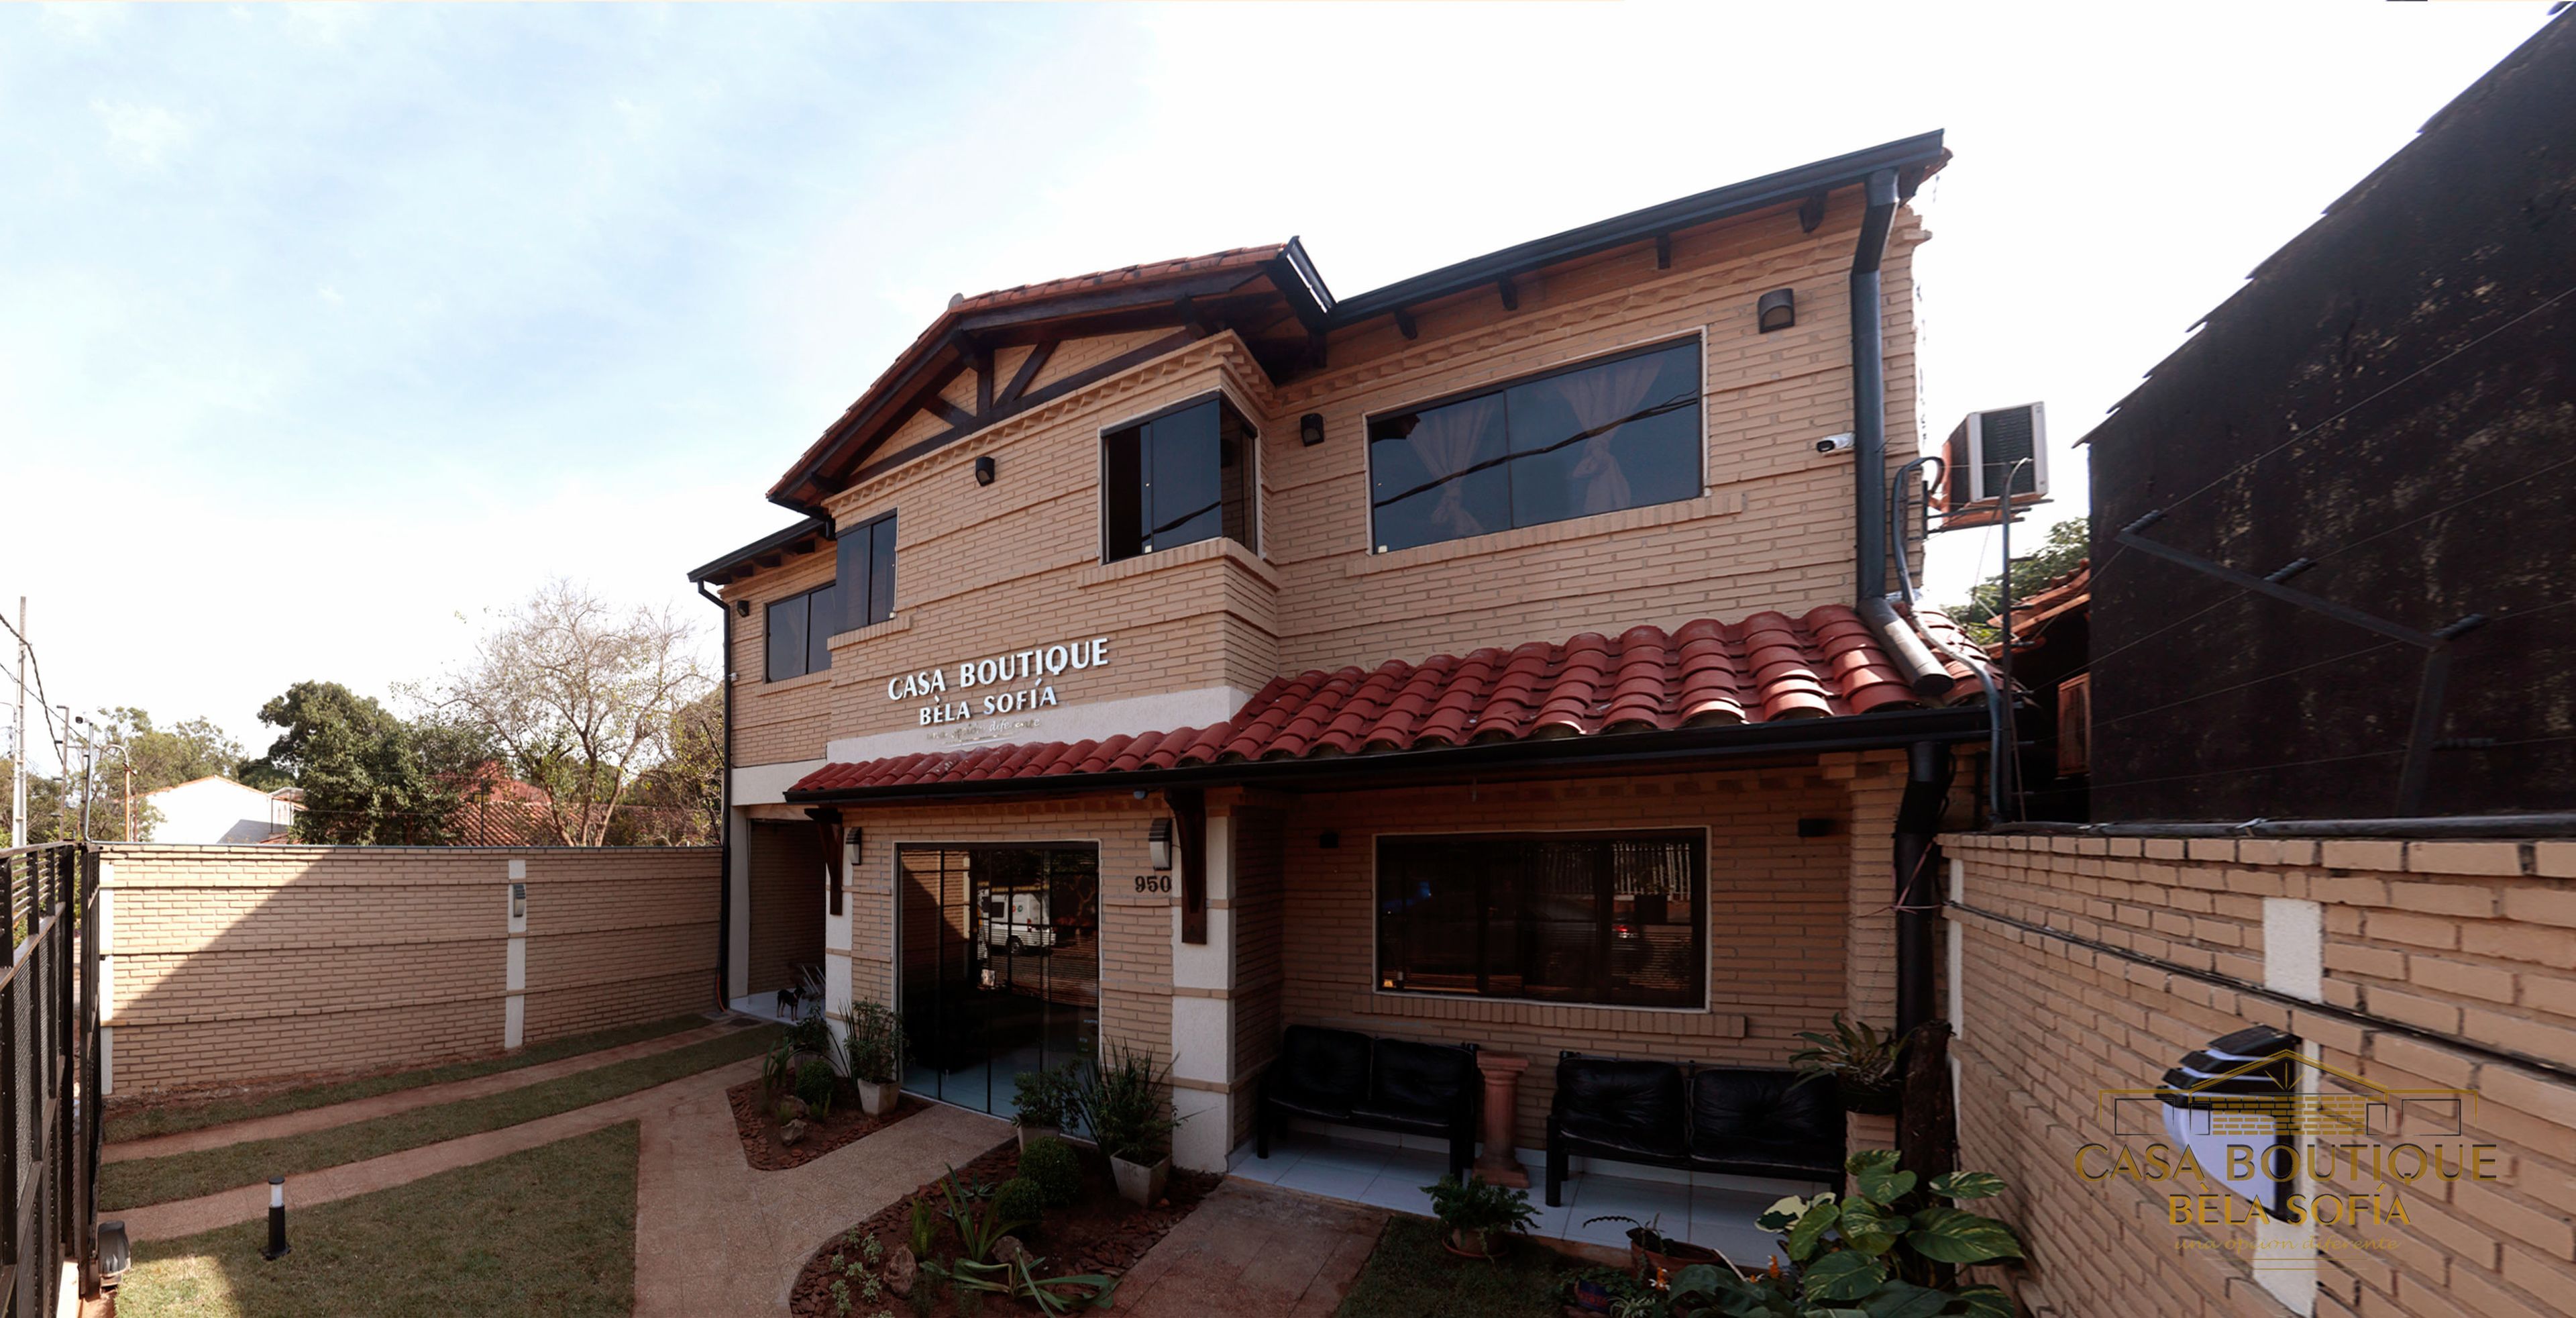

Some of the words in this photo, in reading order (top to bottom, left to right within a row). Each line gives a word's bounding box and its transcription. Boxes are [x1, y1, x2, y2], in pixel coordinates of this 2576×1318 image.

[888, 669, 946, 701] CASA
[960, 638, 1109, 689] BOUTIQUE
[983, 678, 1057, 715] SOFÍA
[1135, 875, 1171, 893] 950
